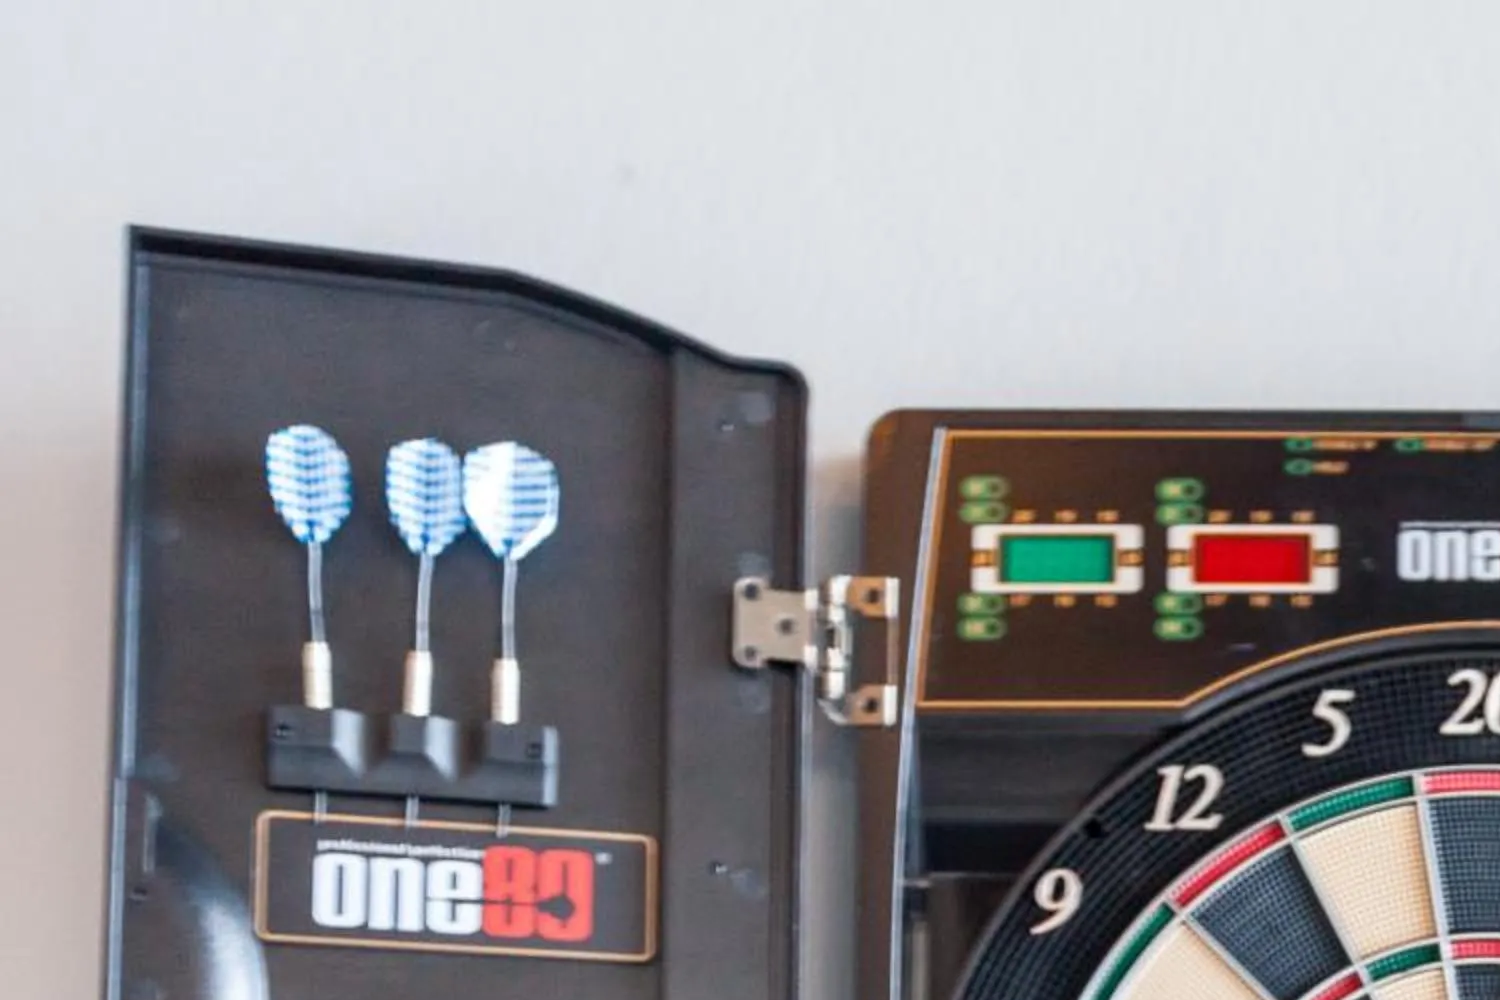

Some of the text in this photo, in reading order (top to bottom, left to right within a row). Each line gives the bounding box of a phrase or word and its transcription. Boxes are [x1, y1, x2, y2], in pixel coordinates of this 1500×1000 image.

[1302, 689, 1355, 757] 5
[1144, 764, 1224, 831] 12
[1030, 868, 1084, 935] 9
